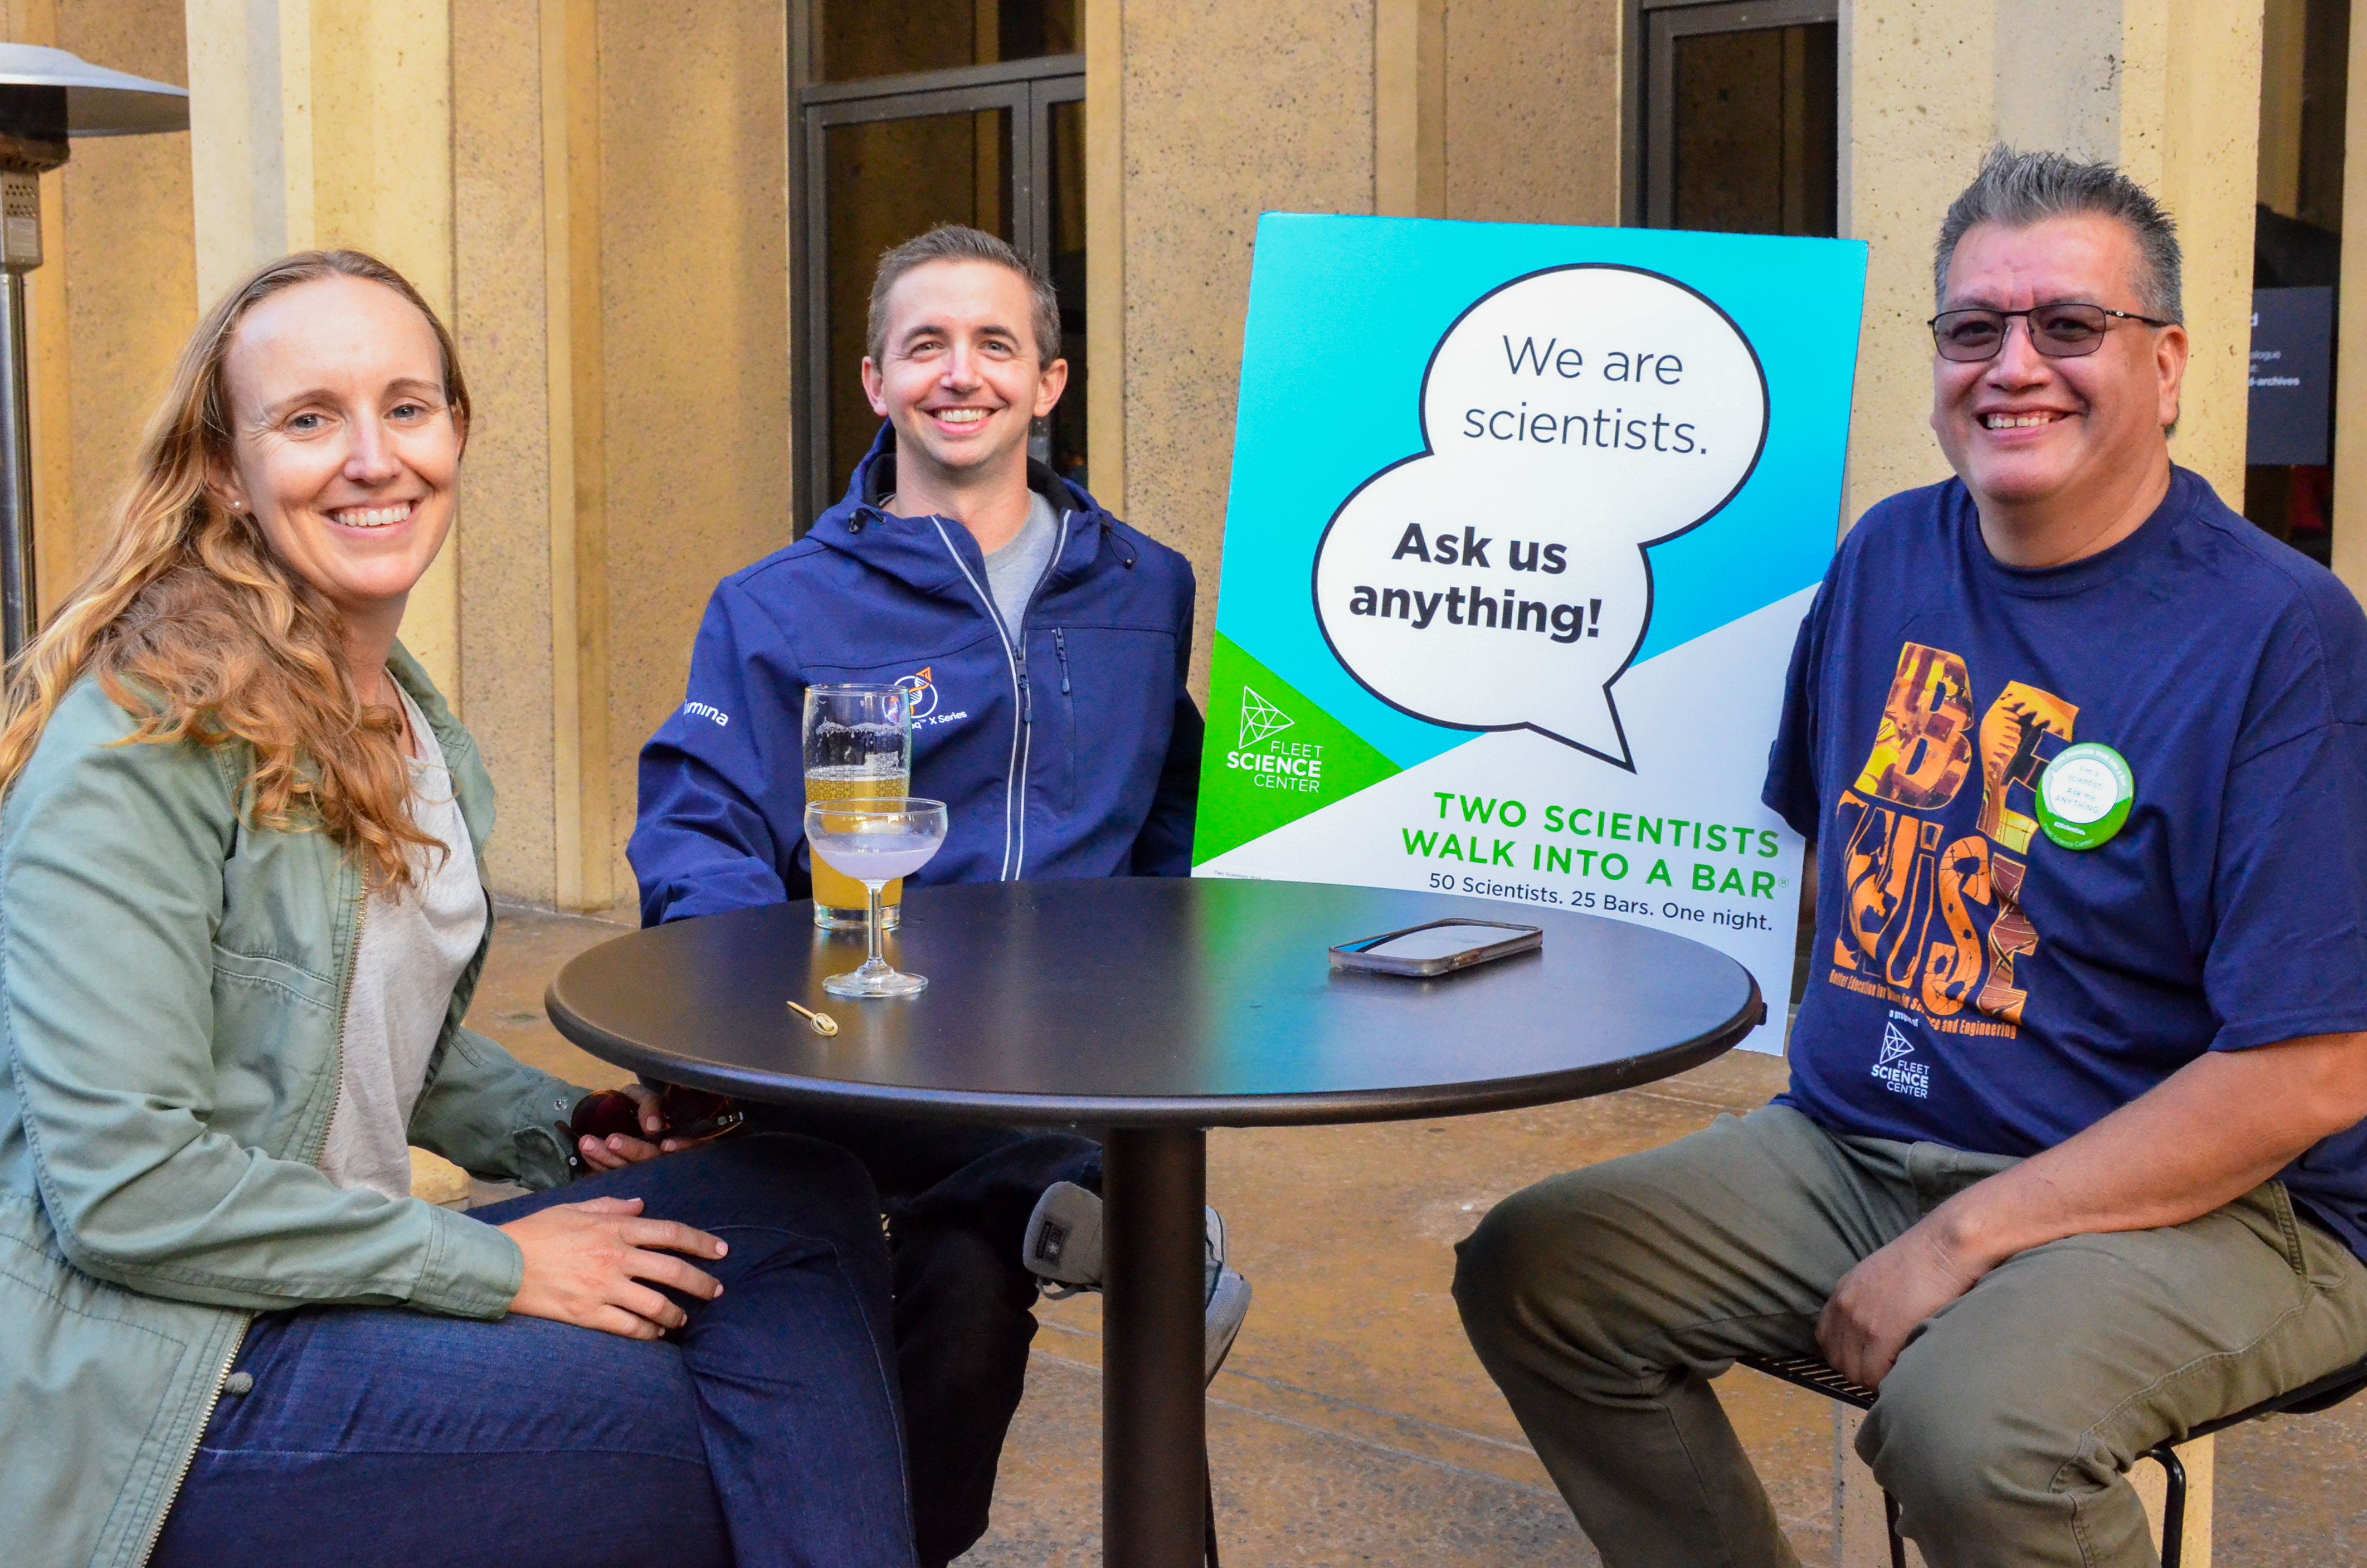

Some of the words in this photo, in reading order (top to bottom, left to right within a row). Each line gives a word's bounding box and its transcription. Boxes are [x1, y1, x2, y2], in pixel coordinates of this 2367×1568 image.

[1503, 335, 1582, 378] We
[1604, 352, 1683, 385] are
[1463, 402, 1707, 455] scientists.
[1391, 523, 1493, 568] Ask
[1508, 540, 1567, 574] us
[1349, 585, 1603, 644] anything!
[928, 717, 938, 725] X
[938, 710, 968, 723] Series
[1271, 741, 1324, 758] FLEET
[1226, 751, 1322, 778] SCIENCE
[1254, 773, 1320, 793] CENTER
[1434, 792, 1527, 827] TWO
[1543, 805, 1779, 858] SCIENTISTS
[1402, 827, 1516, 867] WALK
[1533, 844, 1629, 880] INTO
[1646, 859, 1673, 887] A
[1429, 873, 1455, 890] 50
[1462, 876, 1563, 904] Scientists.
[1571, 890, 1595, 908] 25
[1603, 894, 1654, 916] Bars.
[1662, 902, 1705, 922] One
[1713, 909, 1772, 931] night.
[1941, 1019, 1959, 1033] and
[1959, 1019, 2017, 1039] Engineering
[1871, 1064, 1929, 1089] SCIENCE
[1897, 1059, 1930, 1075] FLEET
[1886, 1081, 1928, 1099] CENTER
